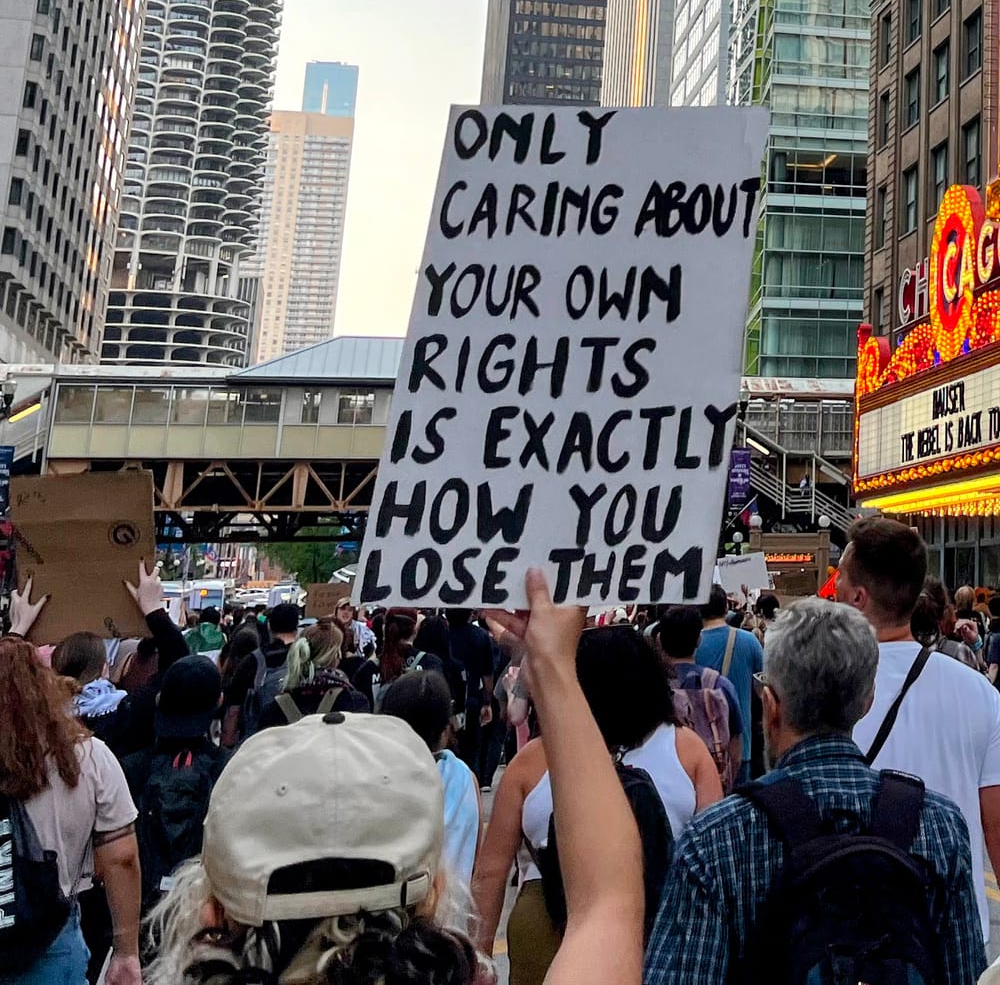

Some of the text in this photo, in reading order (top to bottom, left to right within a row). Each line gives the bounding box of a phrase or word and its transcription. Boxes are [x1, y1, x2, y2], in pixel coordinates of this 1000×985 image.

[454, 110, 618, 164] ONLY
[439, 177, 761, 238] CARING ABOUT
[424, 262, 682, 323] YOUR OWN
[407, 334, 657, 398] RIGHTS
[932, 381, 965, 420] HAUSER
[390, 403, 738, 473] IS EXACTLY
[901, 431, 914, 463] THE
[917, 424, 941, 459] REBEL
[945, 421, 953, 451] IS
[958, 411, 982, 448] BACK
[375, 478, 683, 547] HOW YOU
[359, 545, 703, 605] LOSE THEM
